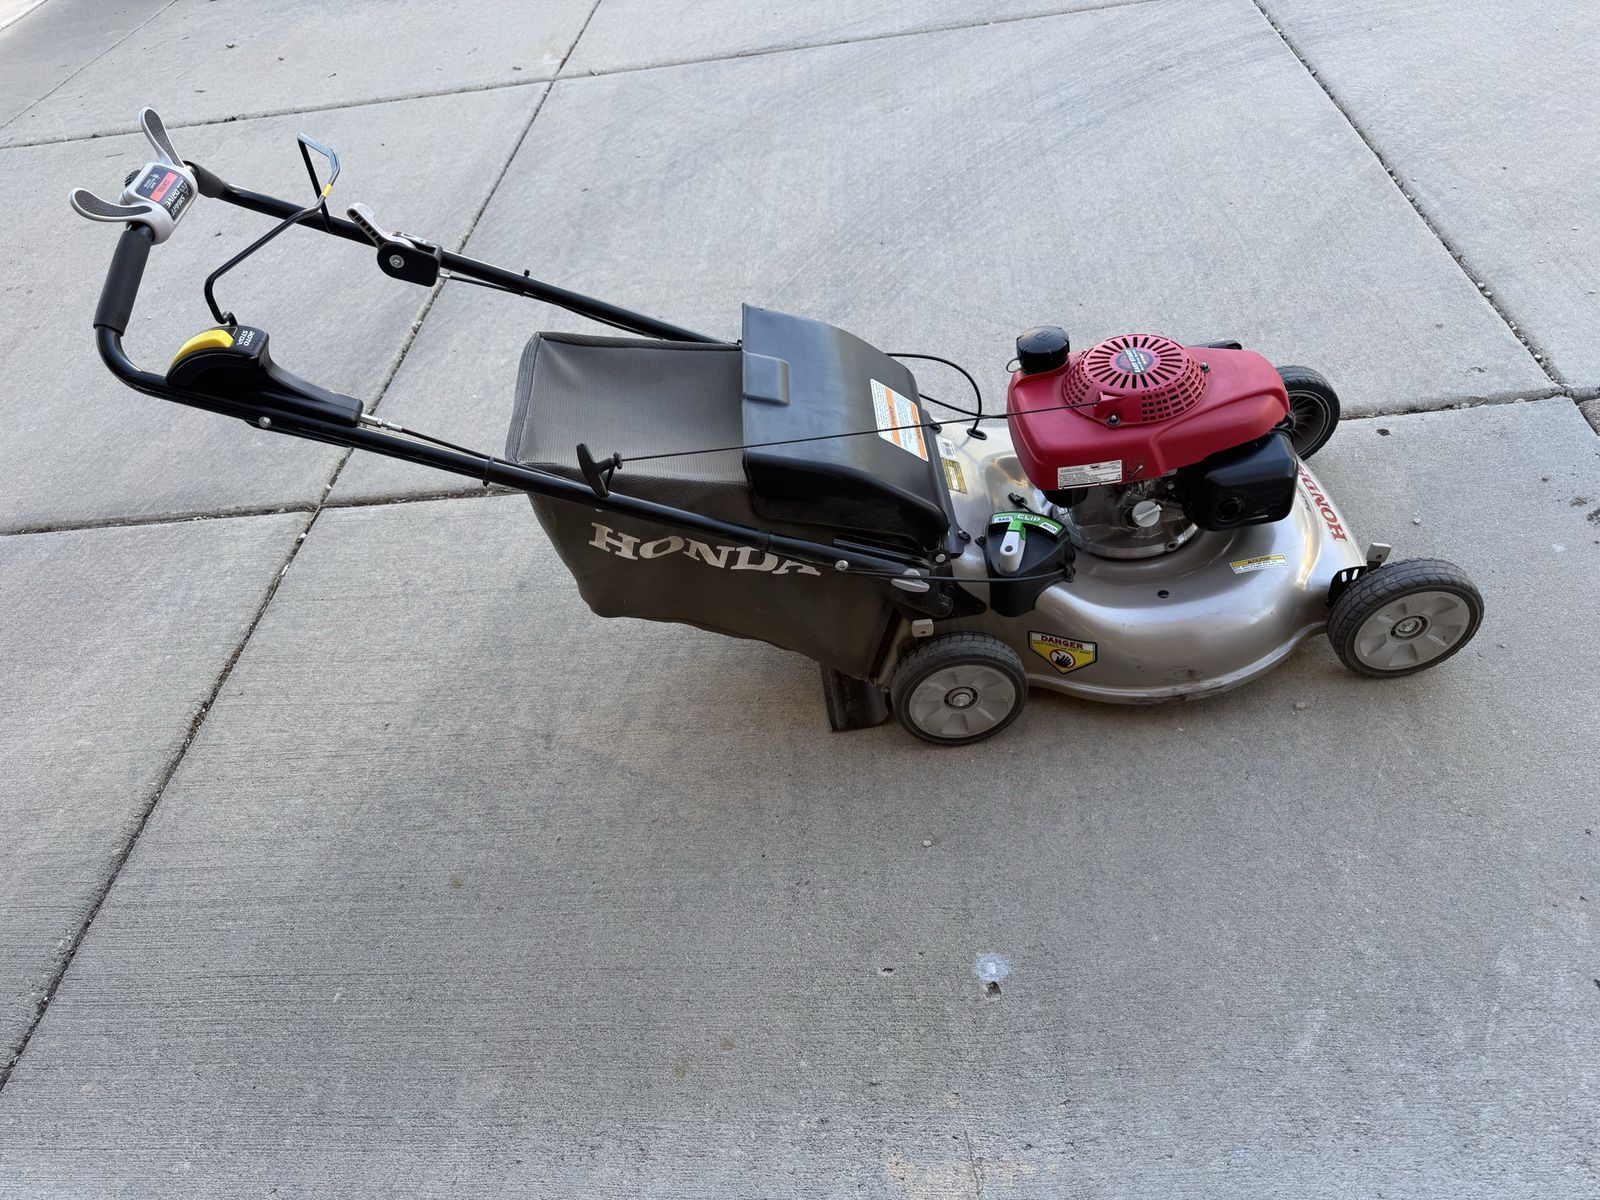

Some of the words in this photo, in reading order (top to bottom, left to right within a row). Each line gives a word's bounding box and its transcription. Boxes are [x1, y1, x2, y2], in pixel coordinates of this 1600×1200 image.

[165, 189, 180, 208] DRIVE
[171, 194, 185, 216] SMART
[243, 331, 255, 346] ROTO
[1297, 464, 1348, 542] HONDA
[1017, 513, 1041, 521] CLIP
[1041, 522, 1056, 532] MULCH
[1040, 635, 1083, 649] DANGER
